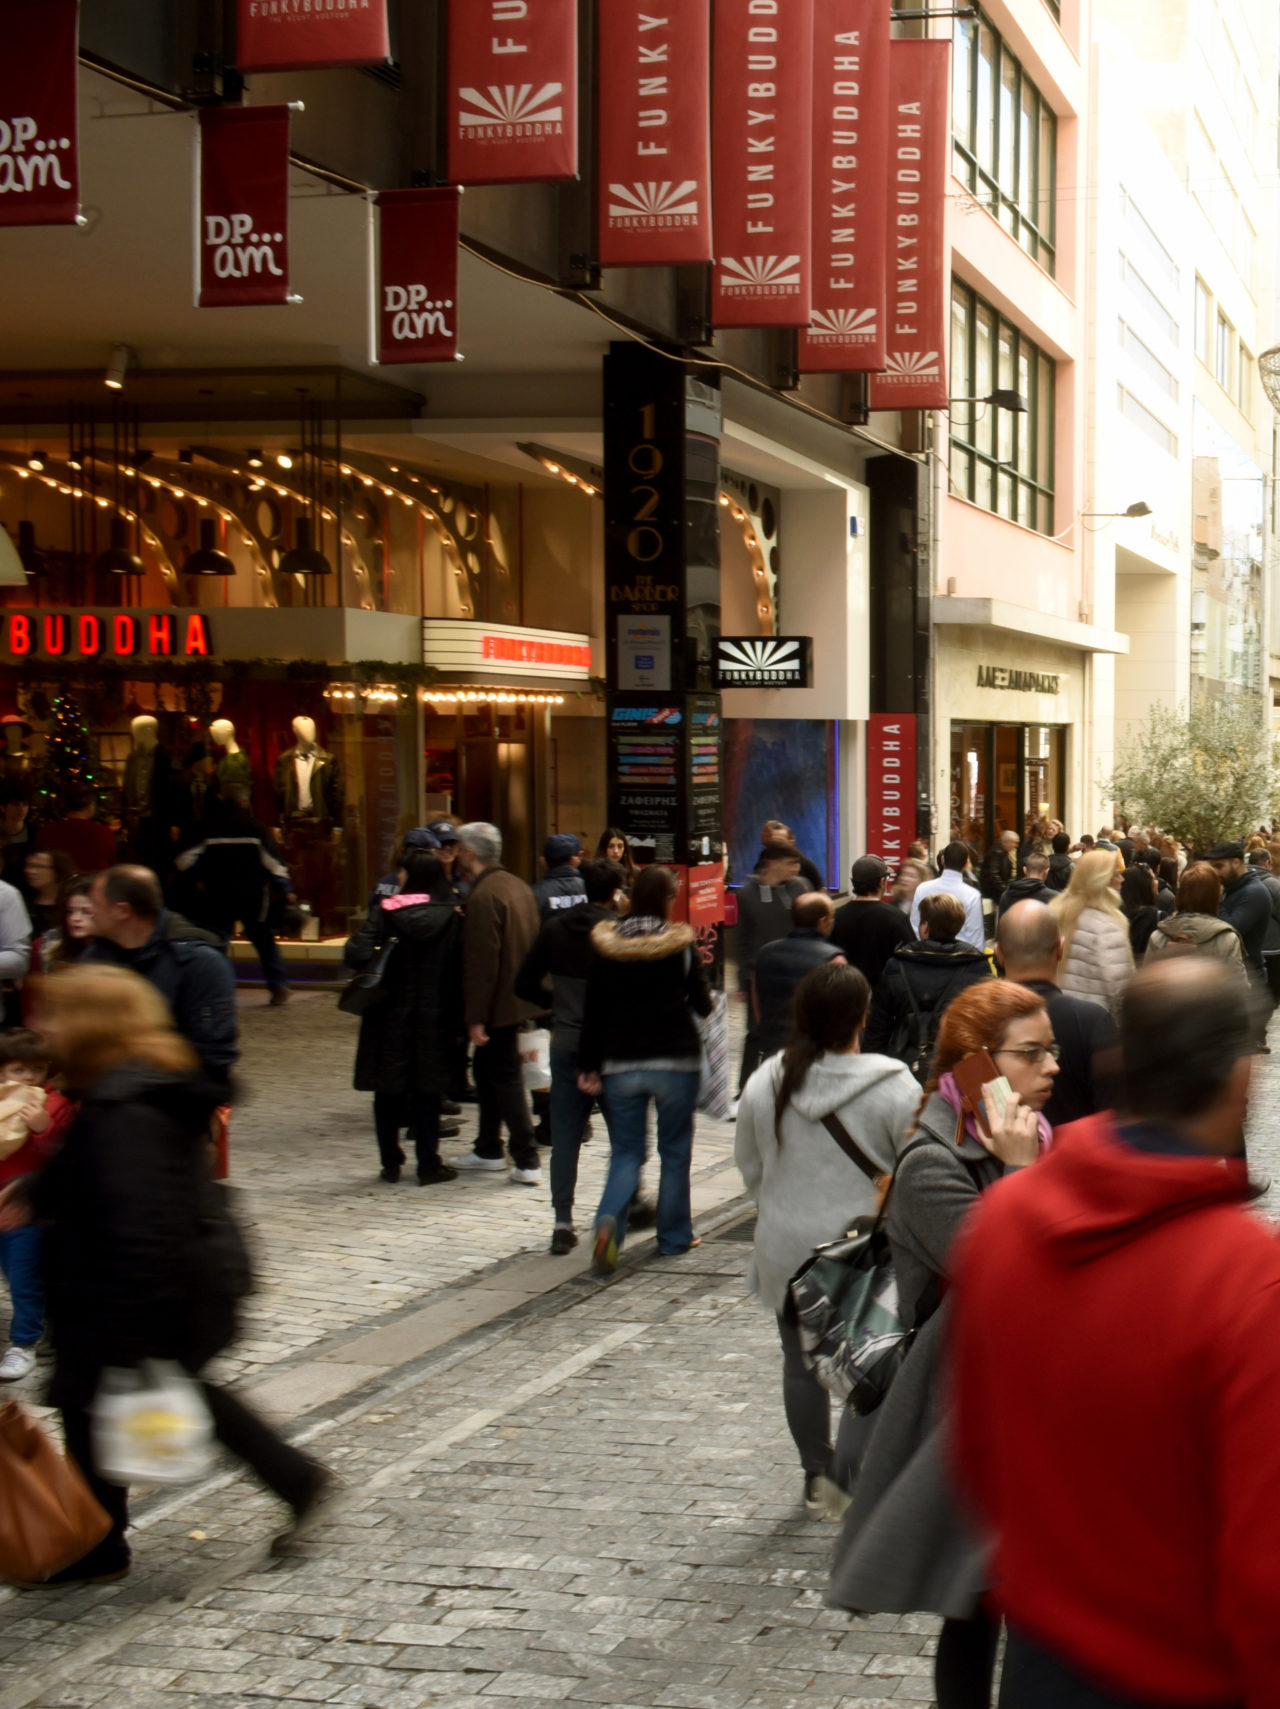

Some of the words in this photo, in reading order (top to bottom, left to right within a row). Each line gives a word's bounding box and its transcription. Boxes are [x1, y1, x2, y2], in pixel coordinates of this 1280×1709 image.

[459, 122, 563, 140] FUNKYBUDDHA
[830, 31, 860, 289] FUNKYBUDDHA
[608, 215, 699, 229] FUNKYBUDDHA
[896, 102, 922, 335] FUNKYBUDDHA
[214, 245, 283, 279] am
[721, 284, 801, 297] FUNKYBUDDHA
[392, 310, 454, 340] am
[806, 334, 877, 345] FUNKYBUDDHA
[718, 670, 801, 681] FUNKYBUDDHA
